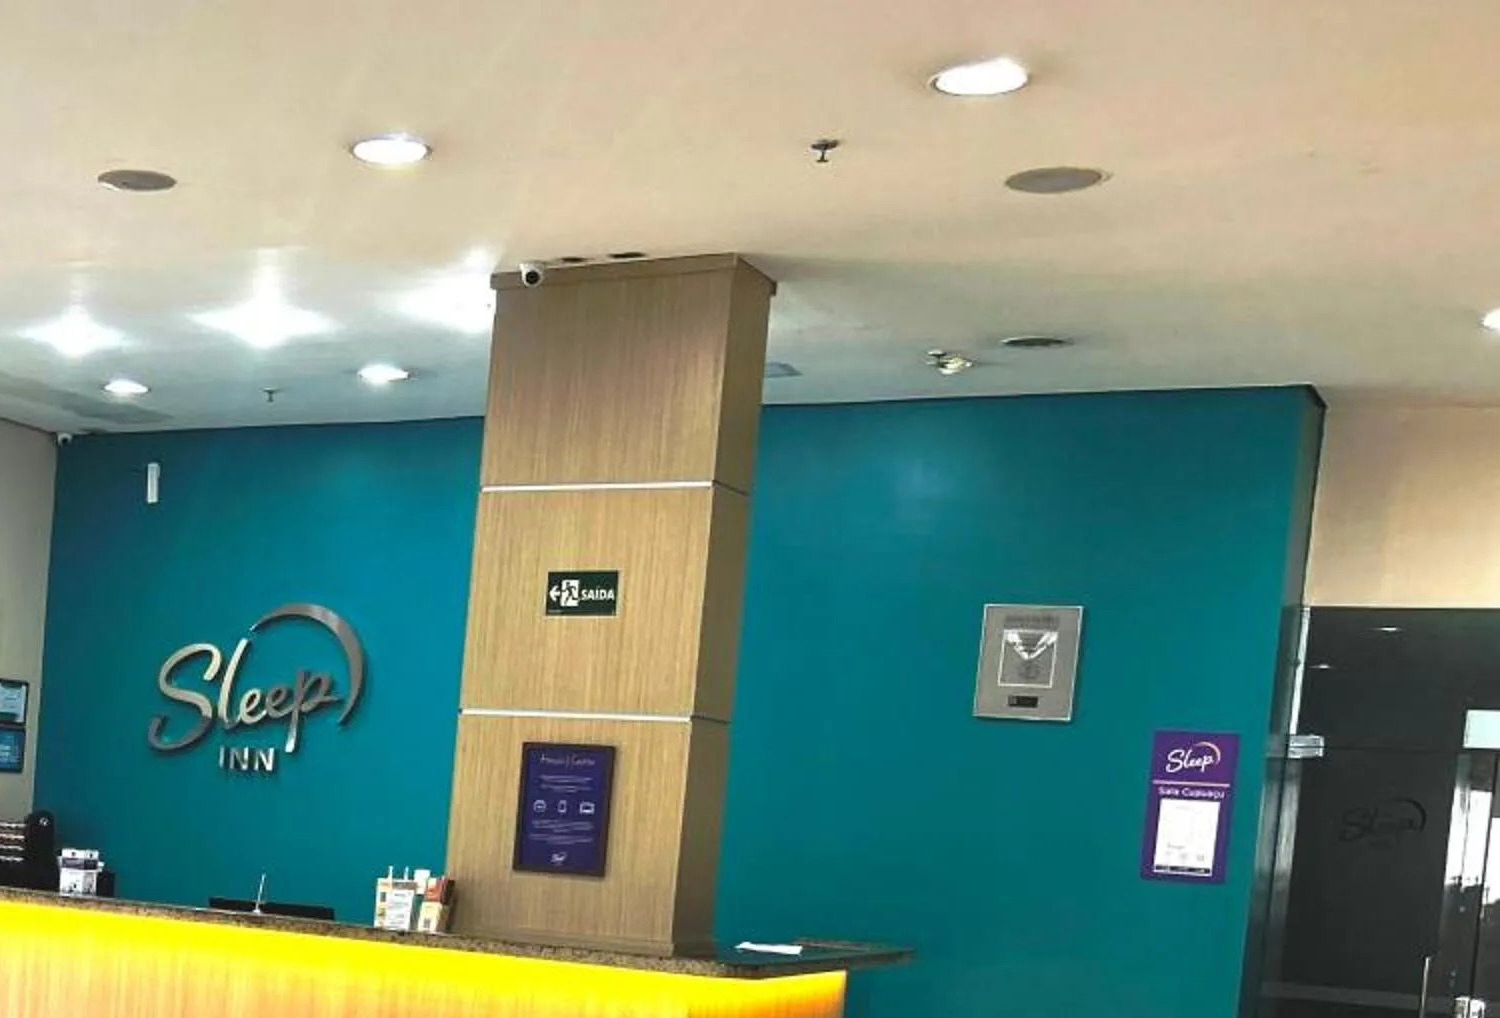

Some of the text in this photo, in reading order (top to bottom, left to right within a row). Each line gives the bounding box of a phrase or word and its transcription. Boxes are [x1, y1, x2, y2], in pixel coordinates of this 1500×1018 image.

[148, 636, 342, 753] Sleep
[219, 747, 275, 771] INN
[1165, 748, 1216, 773] Sleep
